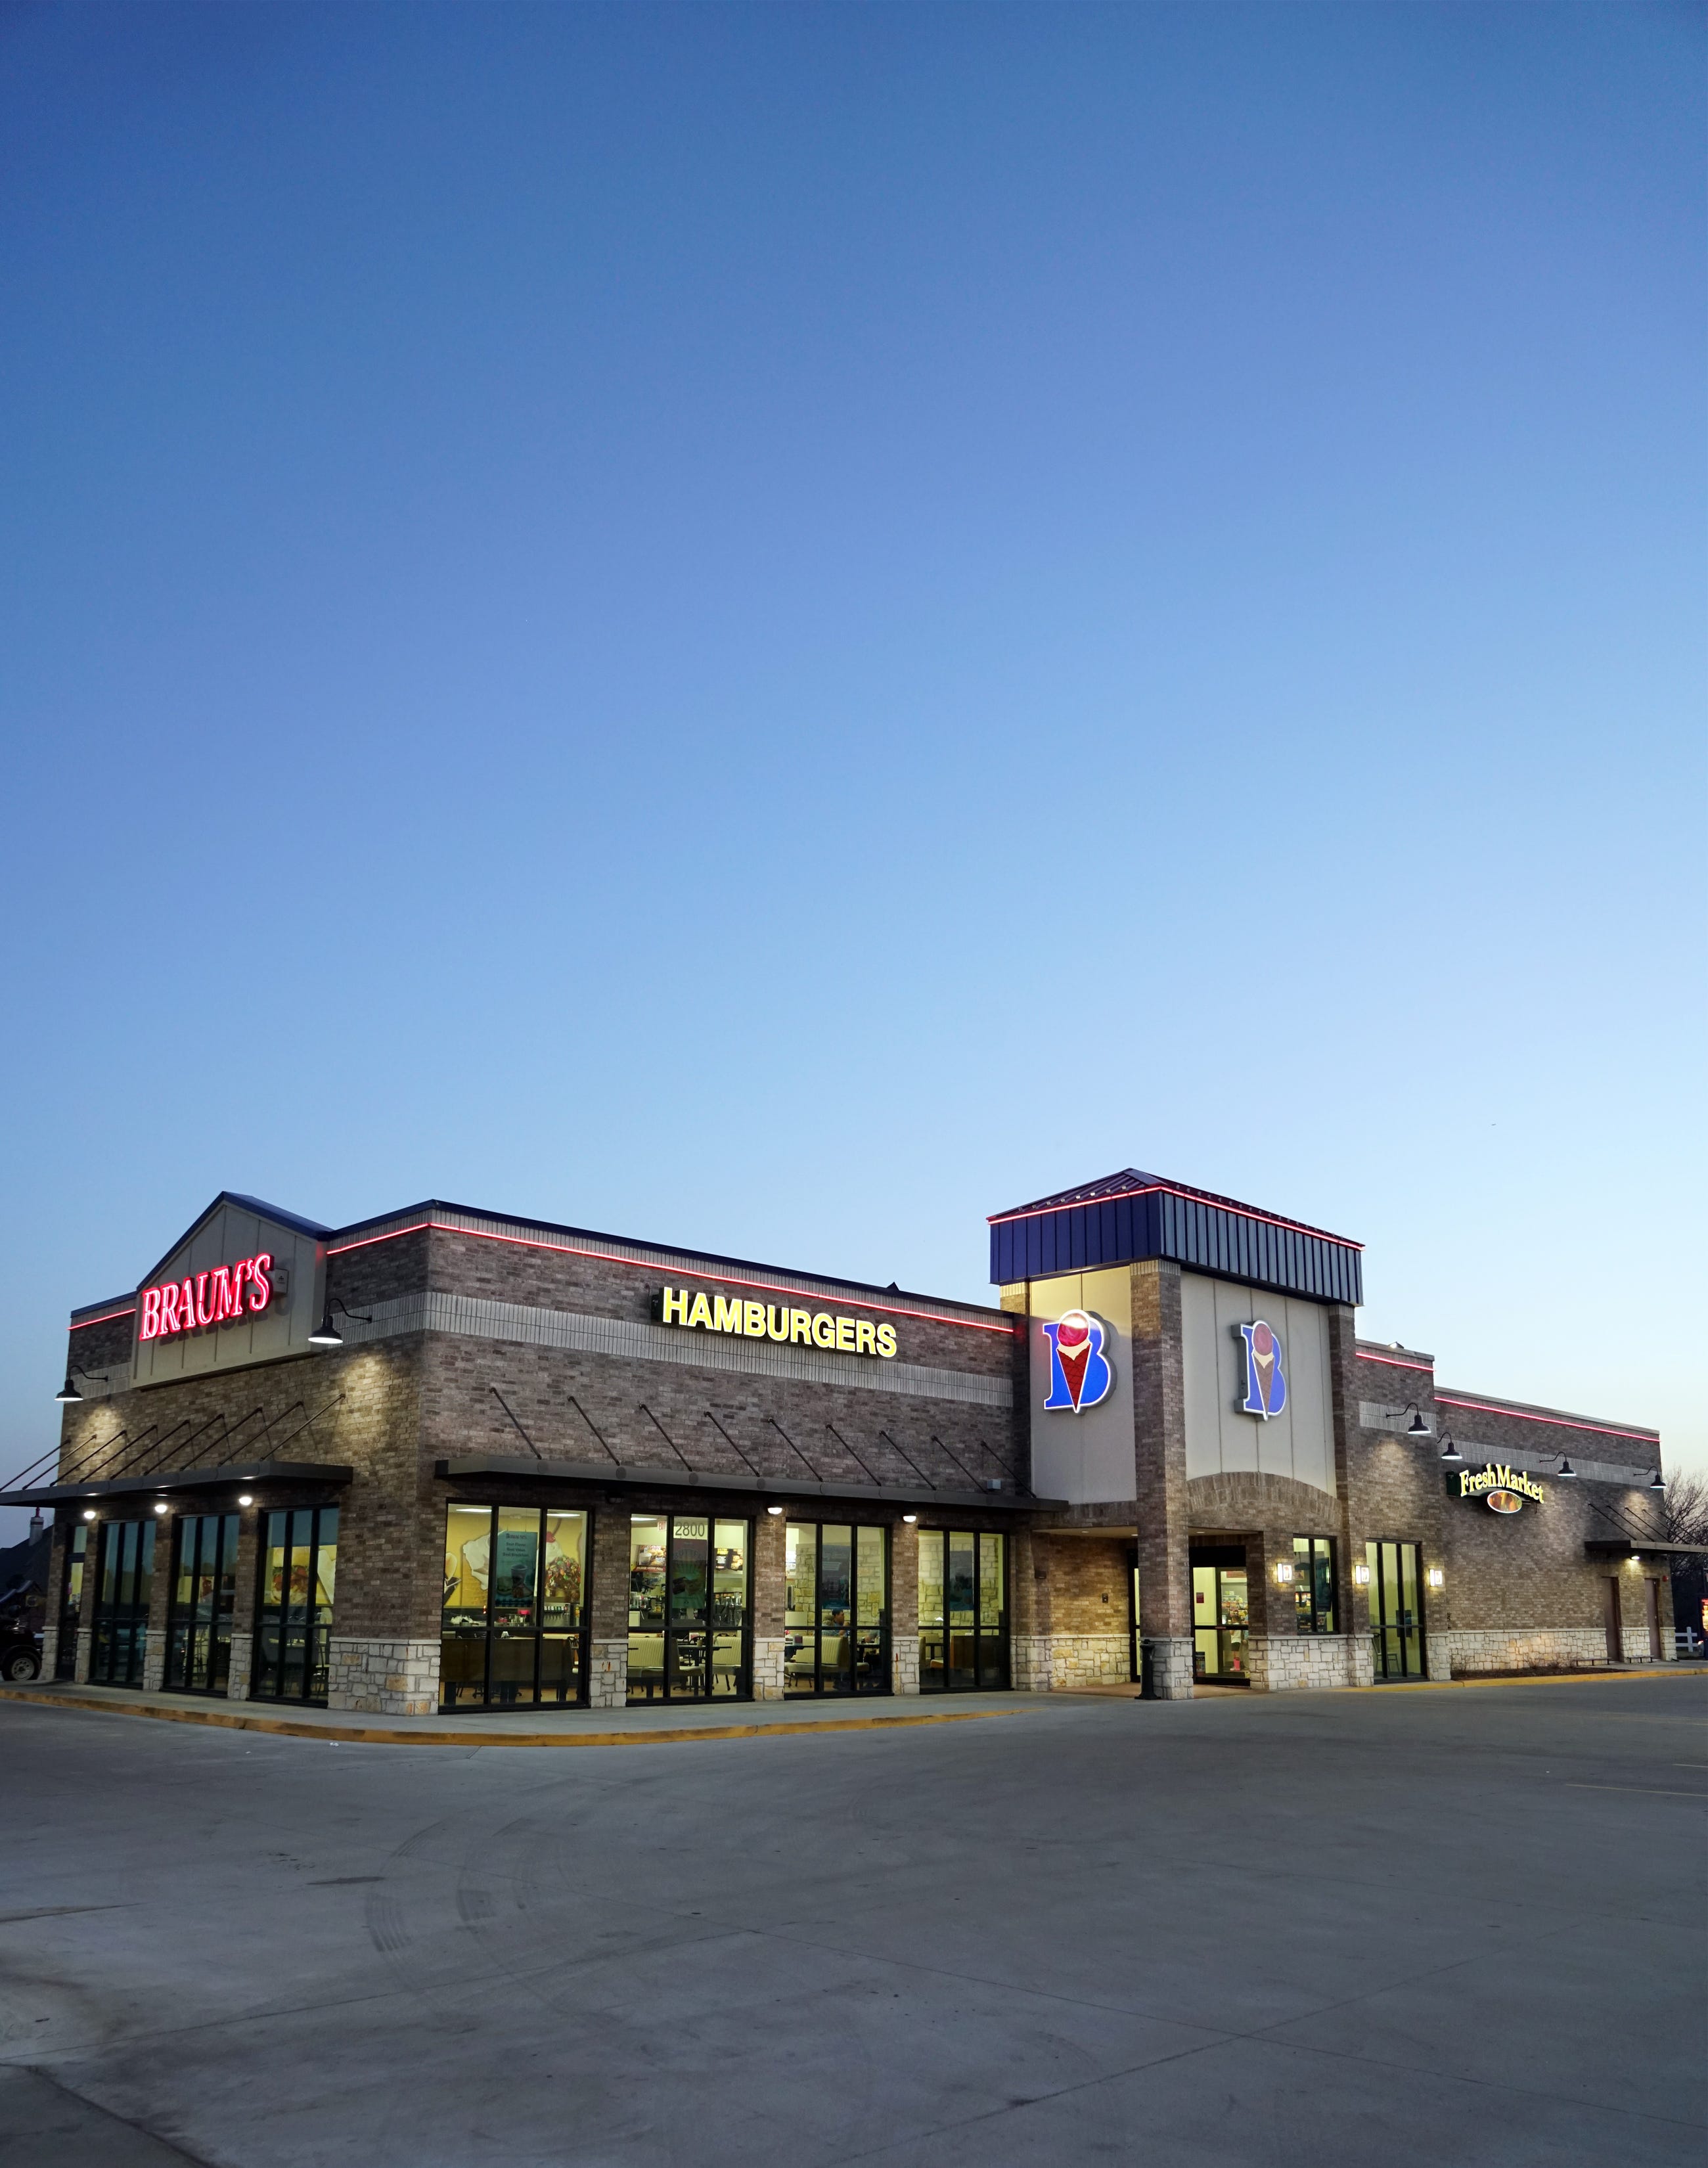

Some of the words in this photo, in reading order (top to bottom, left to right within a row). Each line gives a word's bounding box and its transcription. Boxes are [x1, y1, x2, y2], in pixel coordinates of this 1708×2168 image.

[139, 1253, 271, 1341] BRAUM'S
[662, 1286, 897, 1358] HAMBURGERS
[675, 1522, 705, 1537] 2800
